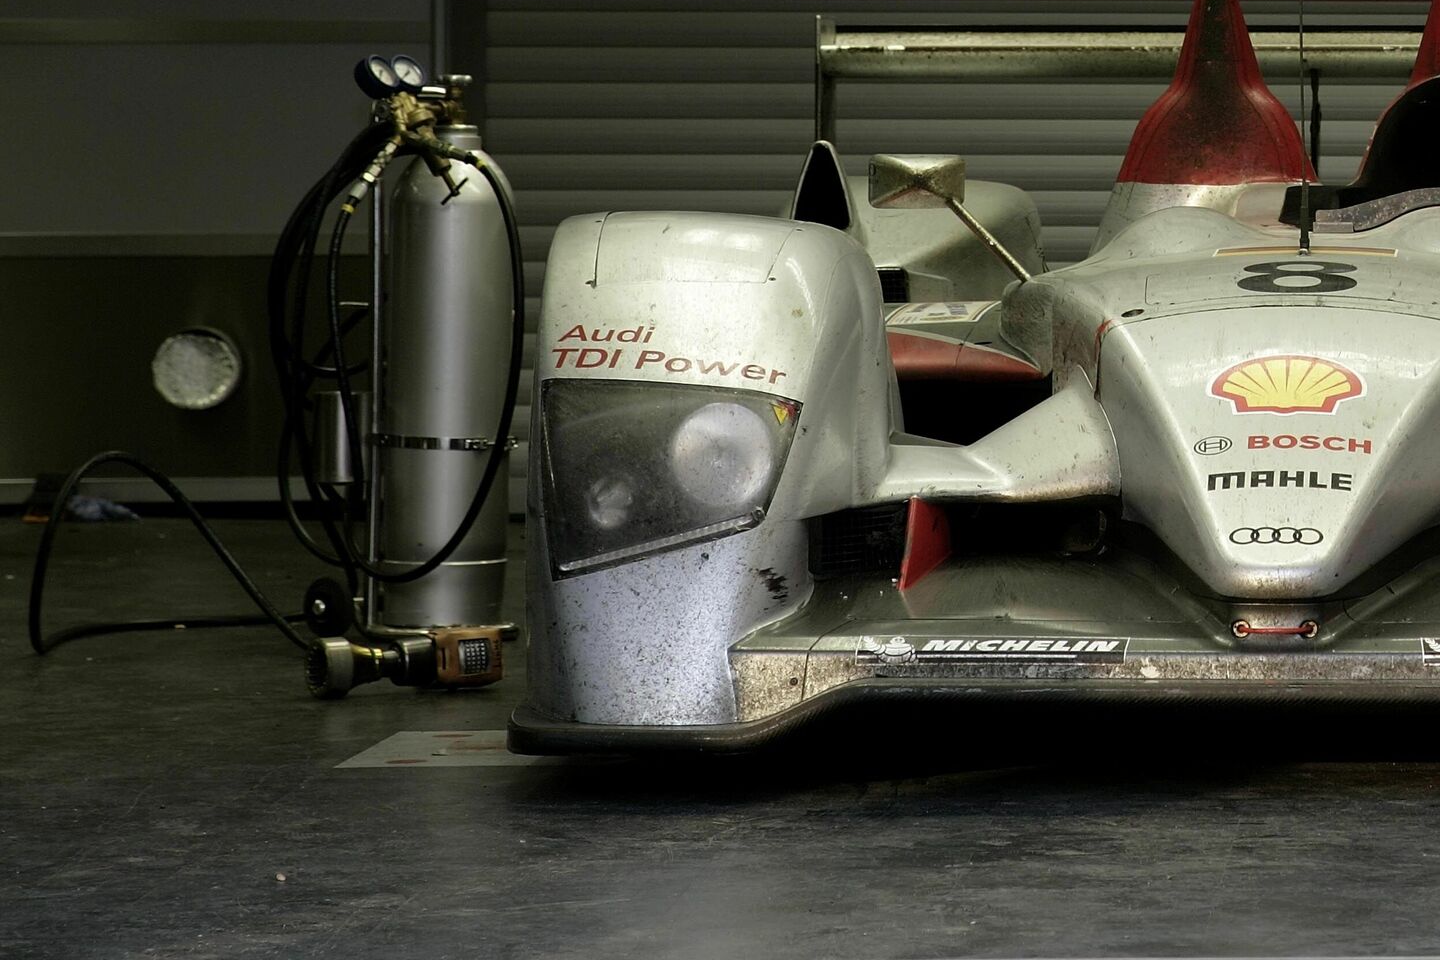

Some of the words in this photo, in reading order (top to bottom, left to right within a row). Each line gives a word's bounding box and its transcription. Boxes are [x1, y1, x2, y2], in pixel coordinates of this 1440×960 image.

[1236, 261, 1358, 294] 8
[558, 324, 656, 343] Audi
[551, 348, 622, 369] TDI
[633, 350, 788, 385] Power
[1247, 435, 1373, 455] BOSCH
[1207, 470, 1353, 492] MAHLE
[922, 638, 1121, 652] MICHELIN
